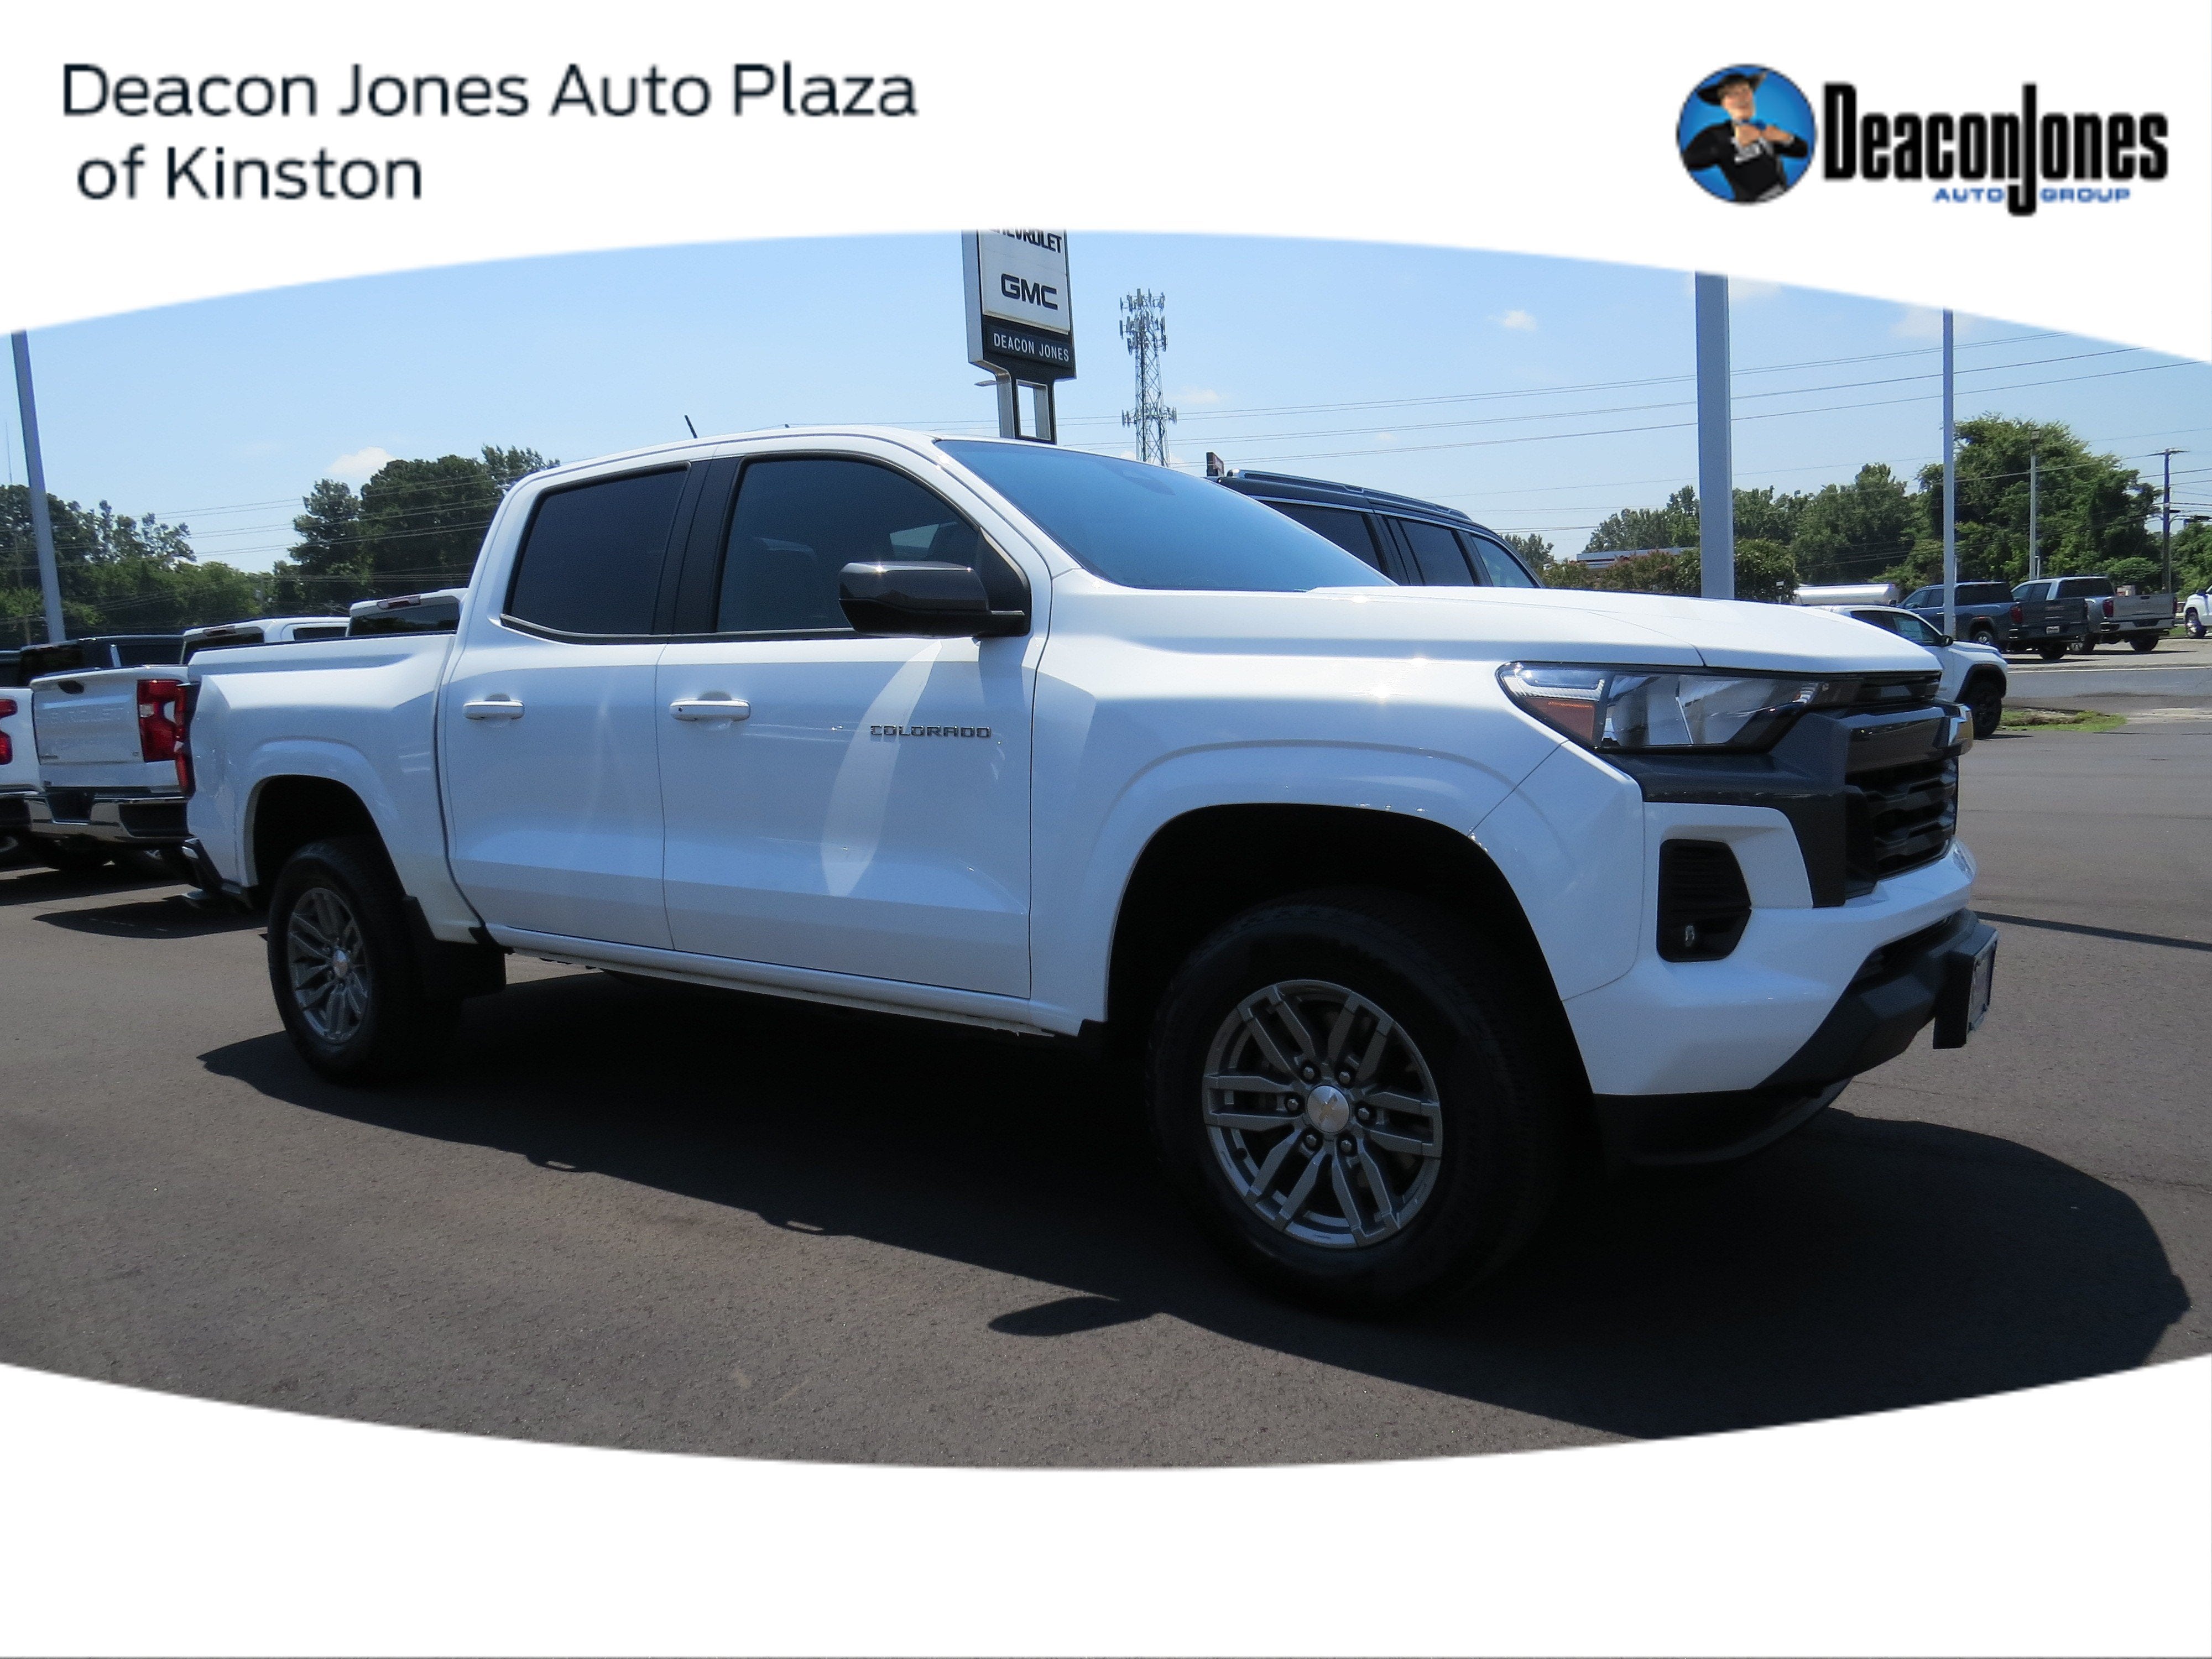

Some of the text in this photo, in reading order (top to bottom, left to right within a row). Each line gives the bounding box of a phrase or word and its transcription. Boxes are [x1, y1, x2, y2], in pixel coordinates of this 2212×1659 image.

[1001, 273, 1058, 311] GMC
[993, 332, 1070, 362] DEACON JONES
[870, 724, 992, 738] COLORADO
